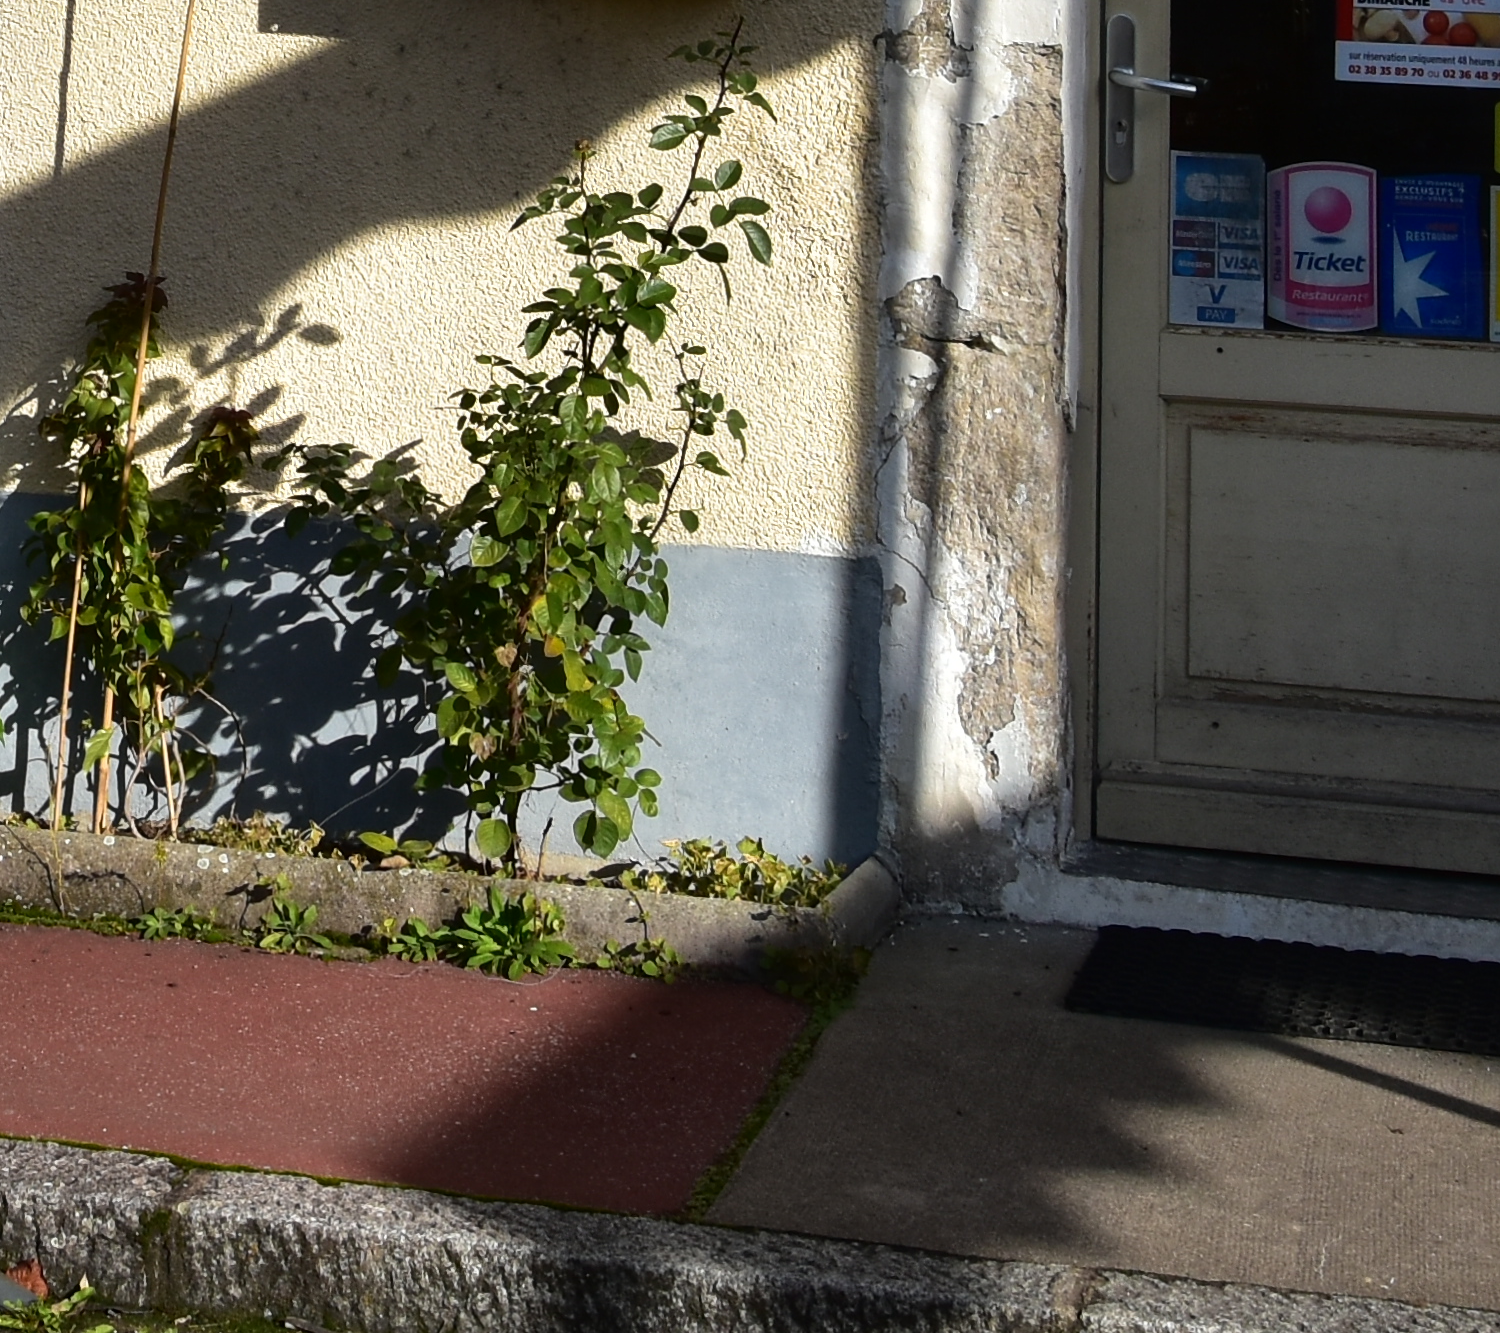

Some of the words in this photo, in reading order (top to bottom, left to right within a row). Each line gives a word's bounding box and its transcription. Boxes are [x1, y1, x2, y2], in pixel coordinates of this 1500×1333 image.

[1347, 64, 1361, 74] 02
[1363, 64, 1377, 75] 38
[1379, 65, 1393, 76] 35
[1411, 66, 1425, 77] 70
[1427, 69, 1440, 79] ou
[1442, 68, 1456, 79] 02
[1458, 69, 1472, 80] 36
[1474, 70, 1489, 81] 48
[1394, 186, 1454, 197] EXCLUSIFS
[1221, 225, 1259, 240] VISA
[1222, 255, 1260, 271] VISA
[1293, 251, 1367, 273] Ticket
[1291, 289, 1364, 303] Restaurant
[1204, 307, 1229, 321] PAY
